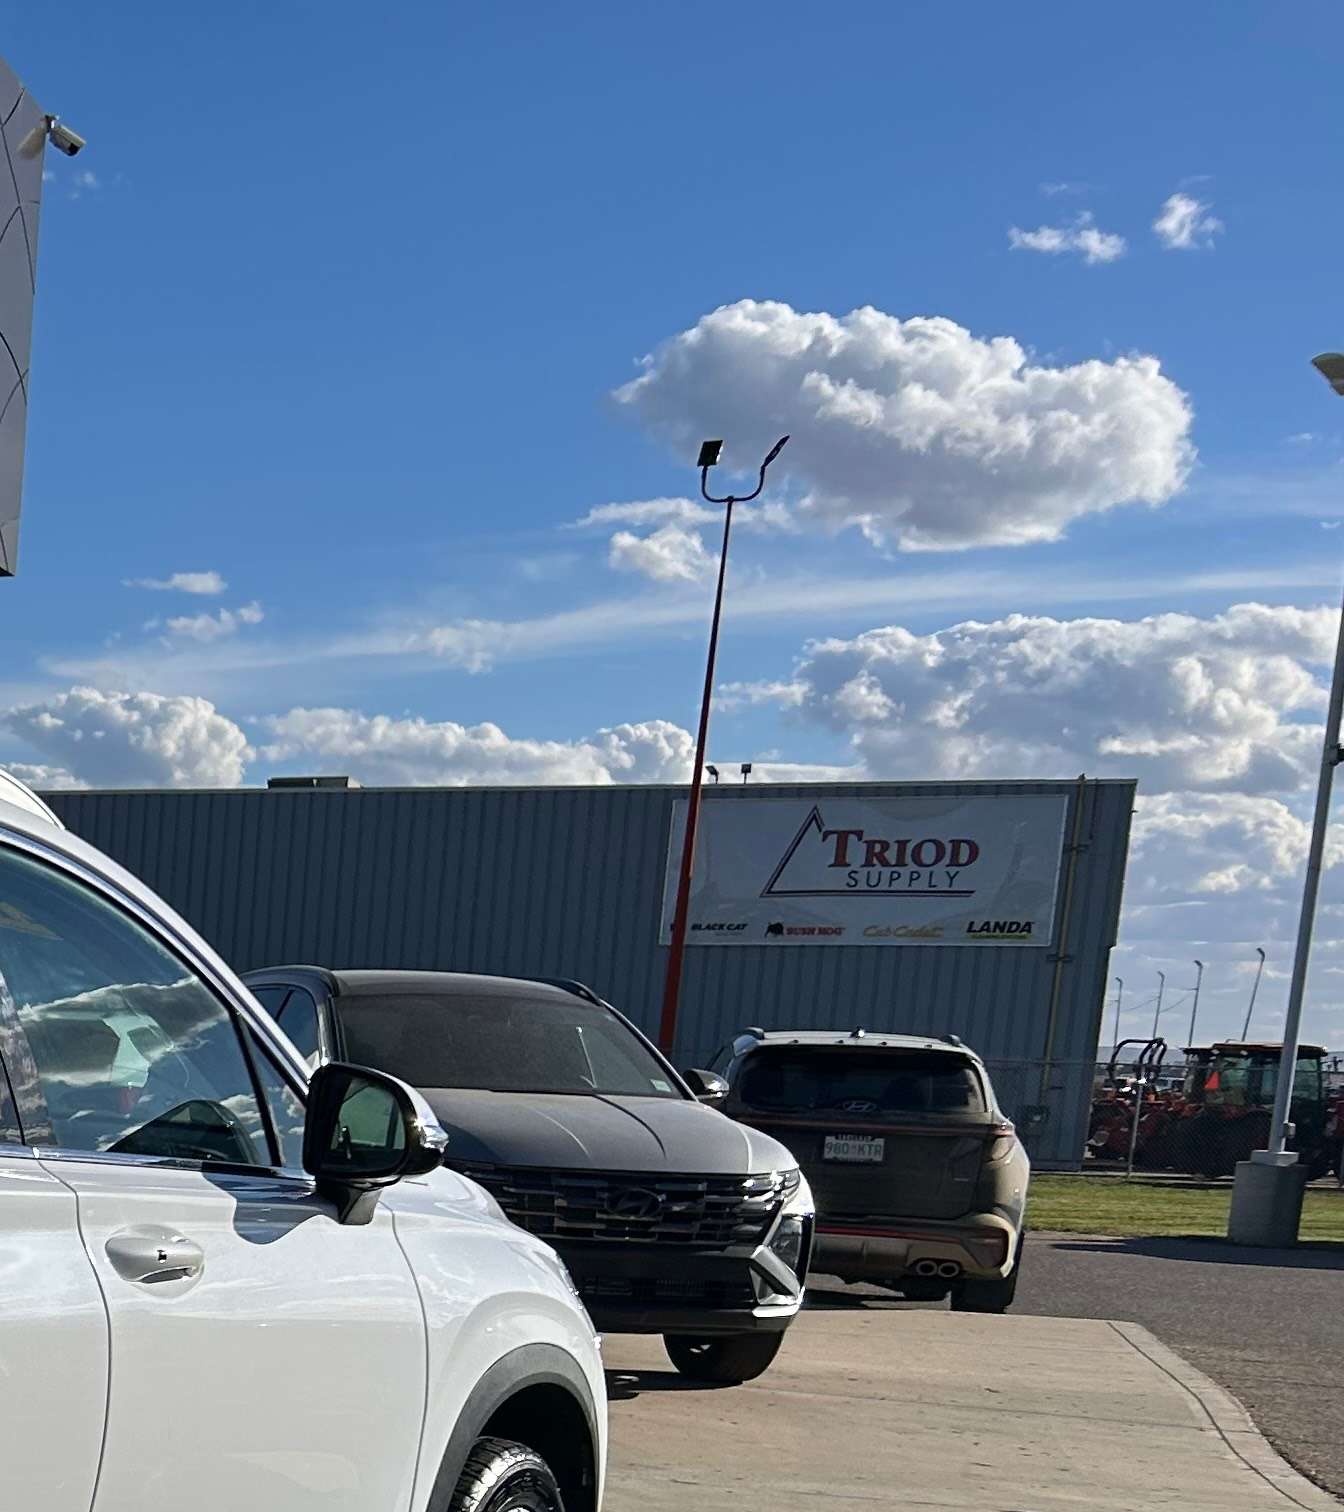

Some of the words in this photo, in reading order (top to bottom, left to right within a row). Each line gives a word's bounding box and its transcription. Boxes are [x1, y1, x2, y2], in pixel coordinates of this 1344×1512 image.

[845, 869, 961, 889] SUPPLY
[690, 922, 725, 932] BLACK
[726, 922, 749, 932] CAT
[965, 920, 1034, 934] LANDA
